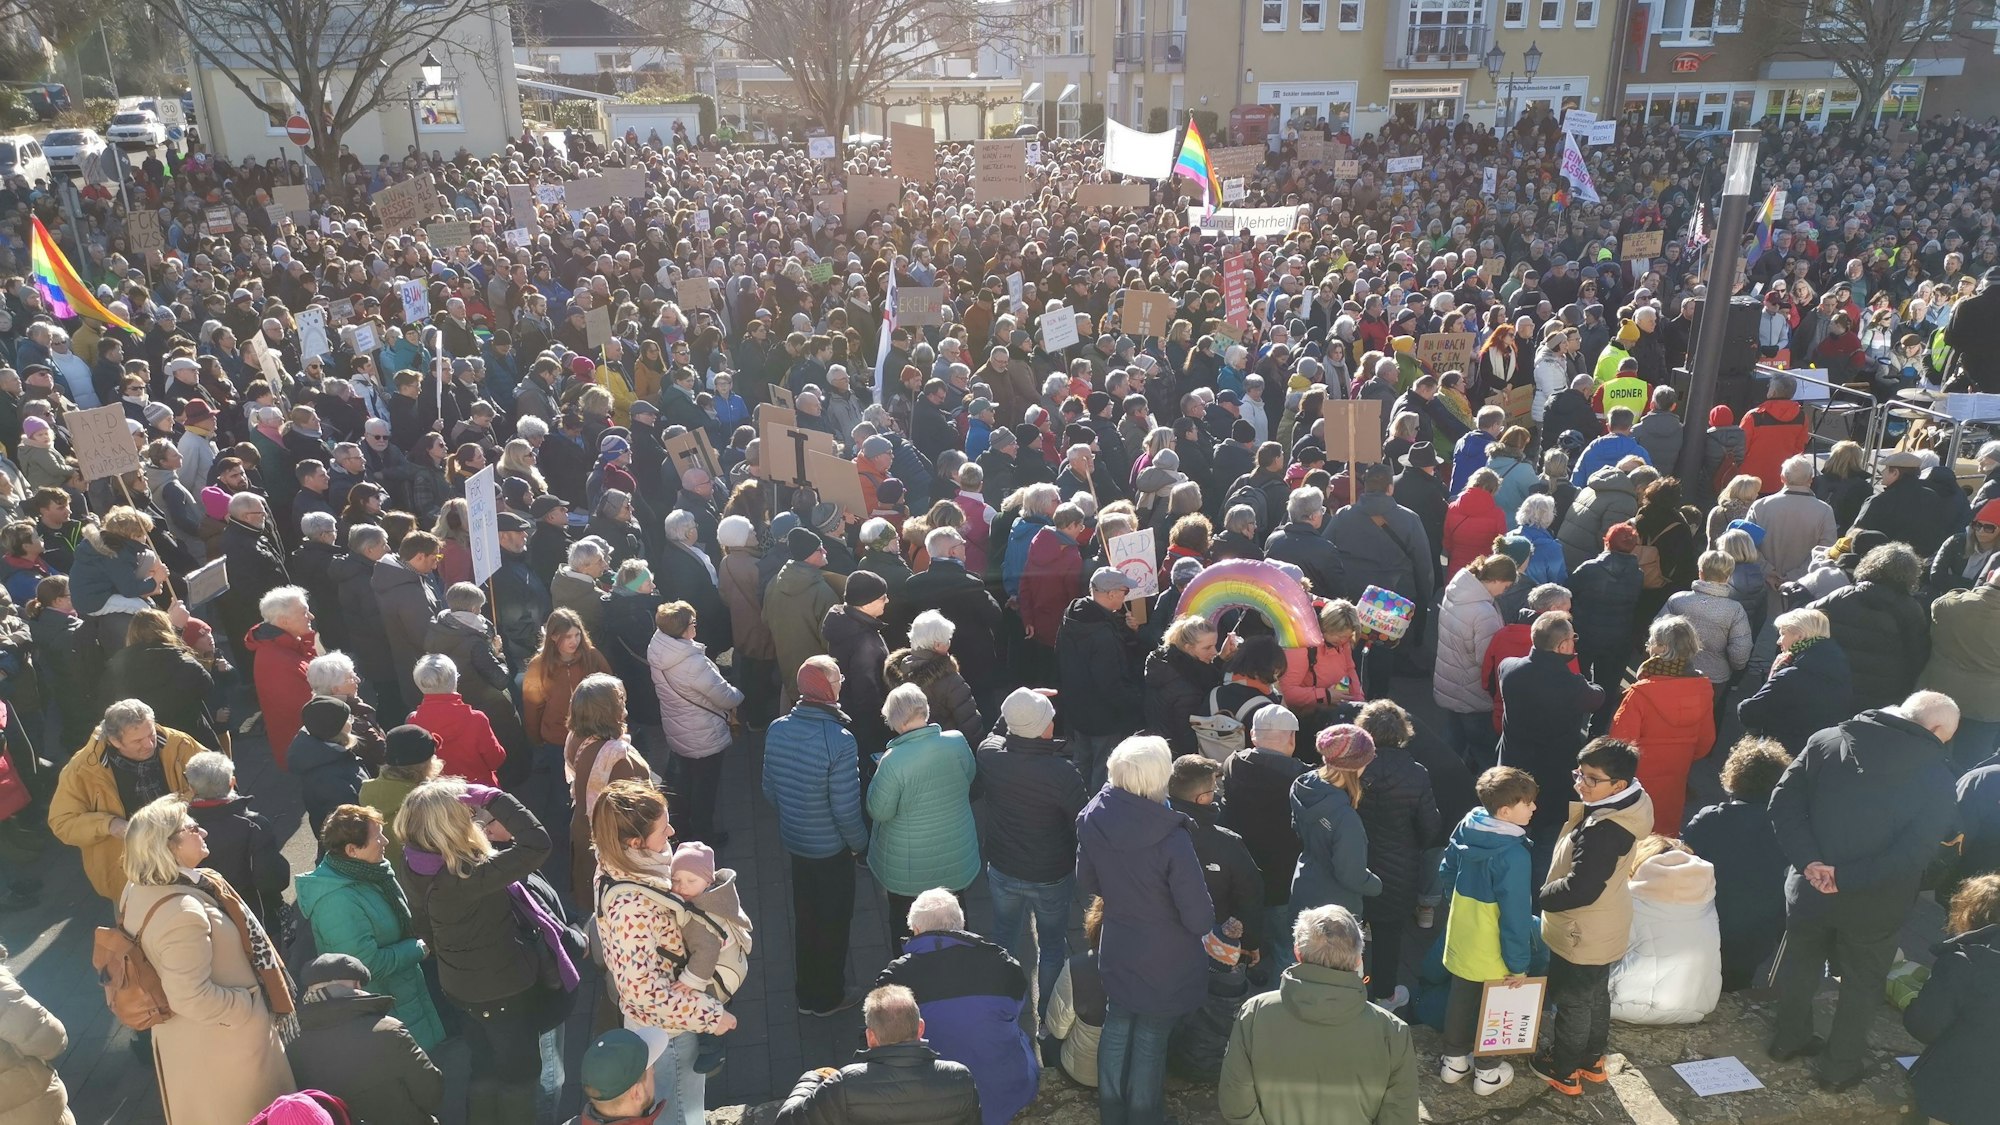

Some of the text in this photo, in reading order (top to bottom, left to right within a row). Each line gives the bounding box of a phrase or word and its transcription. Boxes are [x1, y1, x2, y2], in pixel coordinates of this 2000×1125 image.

[164, 104, 175, 113] 30
[381, 197, 414, 217] BESSER
[418, 190, 432, 203] ALS
[128, 212, 158, 229] FCK
[1201, 215, 1293, 229] Bunte Mehrheit
[403, 285, 427, 304] BUNT
[1424, 339, 1465, 351] RHINBACH
[1431, 352, 1460, 361] GEEN
[1433, 362, 1465, 373] RECHTS
[1610, 389, 1643, 399] ORDNER
[80, 413, 118, 432] AFD
[1483, 1009, 1500, 1046] BUNT
[1502, 1010, 1514, 1045] STATT
[1518, 1015, 1530, 1043] BRAUN
